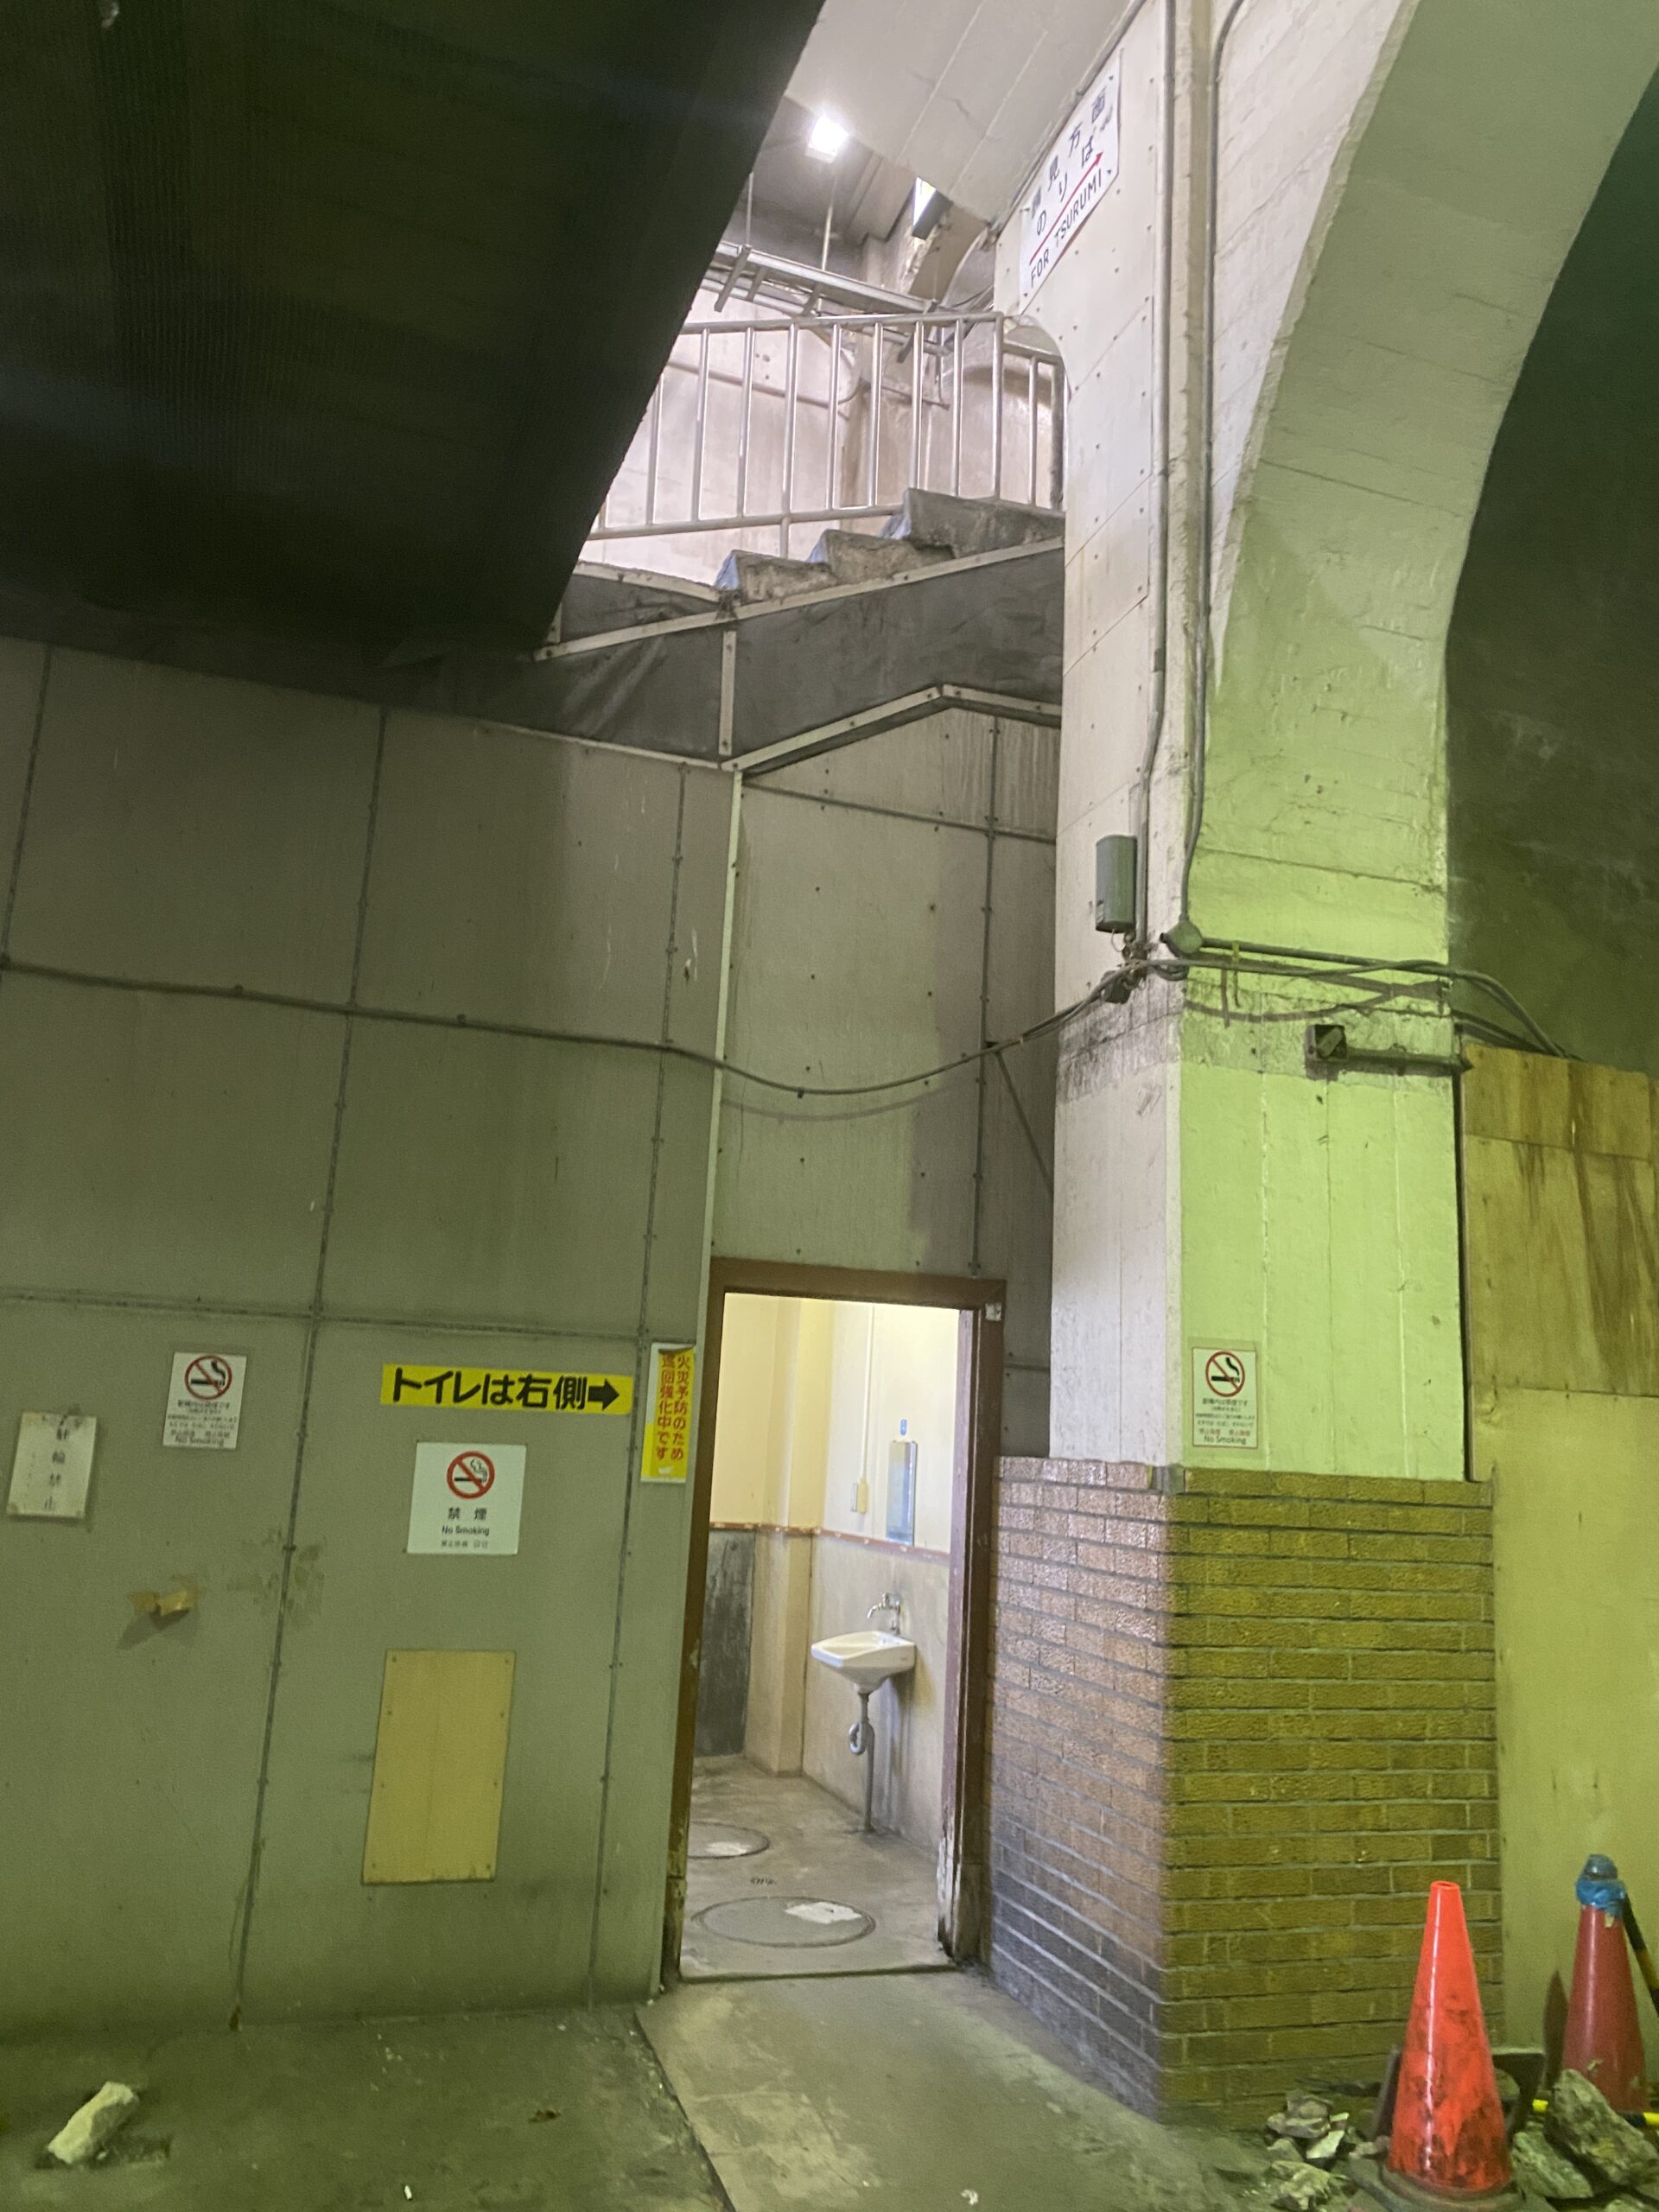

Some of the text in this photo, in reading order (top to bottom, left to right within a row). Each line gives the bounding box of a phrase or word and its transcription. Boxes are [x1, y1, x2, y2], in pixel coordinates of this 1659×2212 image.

[1031, 168, 1103, 288] FOR TSURUMI
[393, 1367, 588, 1410] トイレは右側
[1216, 1435, 1246, 1446] Smoking
[442, 1525, 490, 1536] No Smoking
